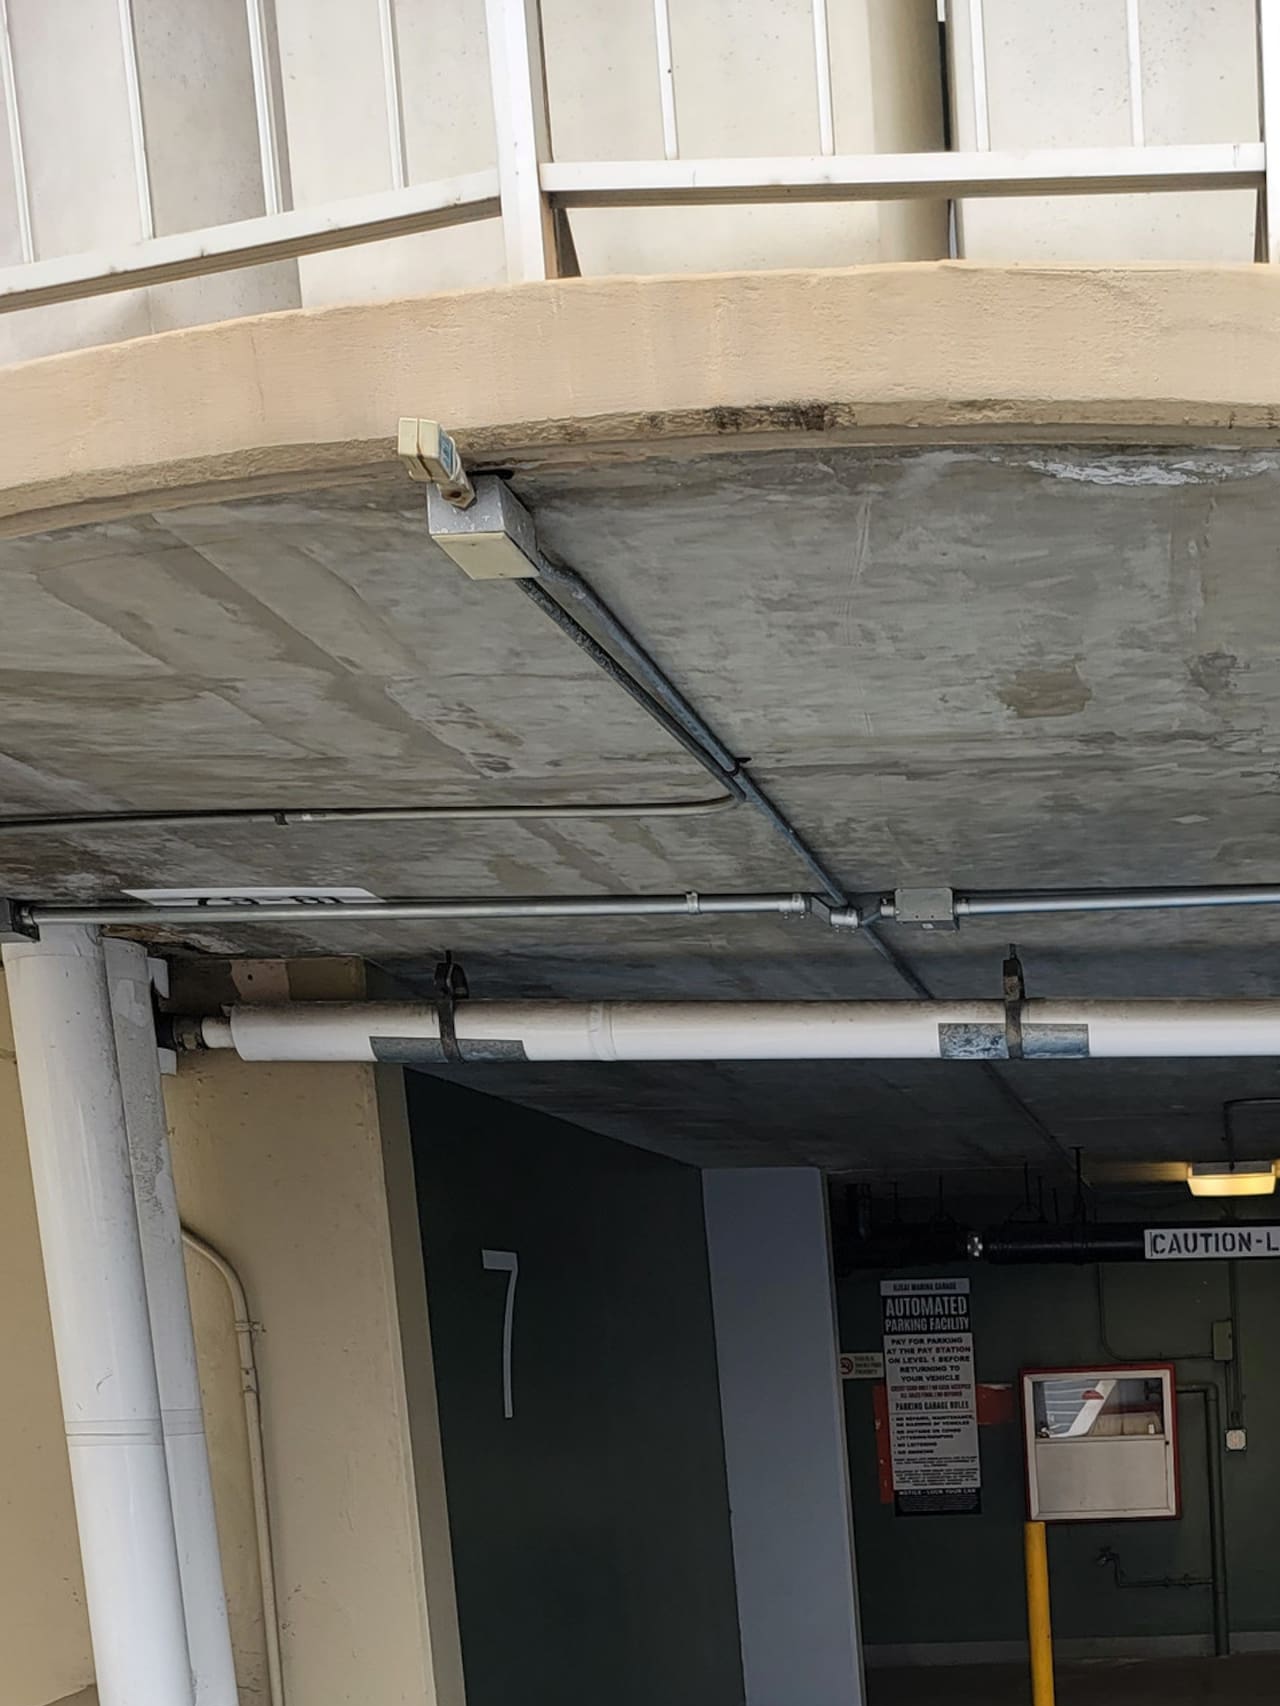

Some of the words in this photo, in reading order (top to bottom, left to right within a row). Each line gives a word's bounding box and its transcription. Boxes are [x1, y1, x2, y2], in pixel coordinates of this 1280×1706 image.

[885, 1296, 967, 1317] AUTOMATED
[481, 1249, 518, 1419] 7
[884, 1318, 927, 1333] PARKING
[929, 1316, 970, 1331] FACILITY
[926, 1374, 960, 1382] VEHICLE
